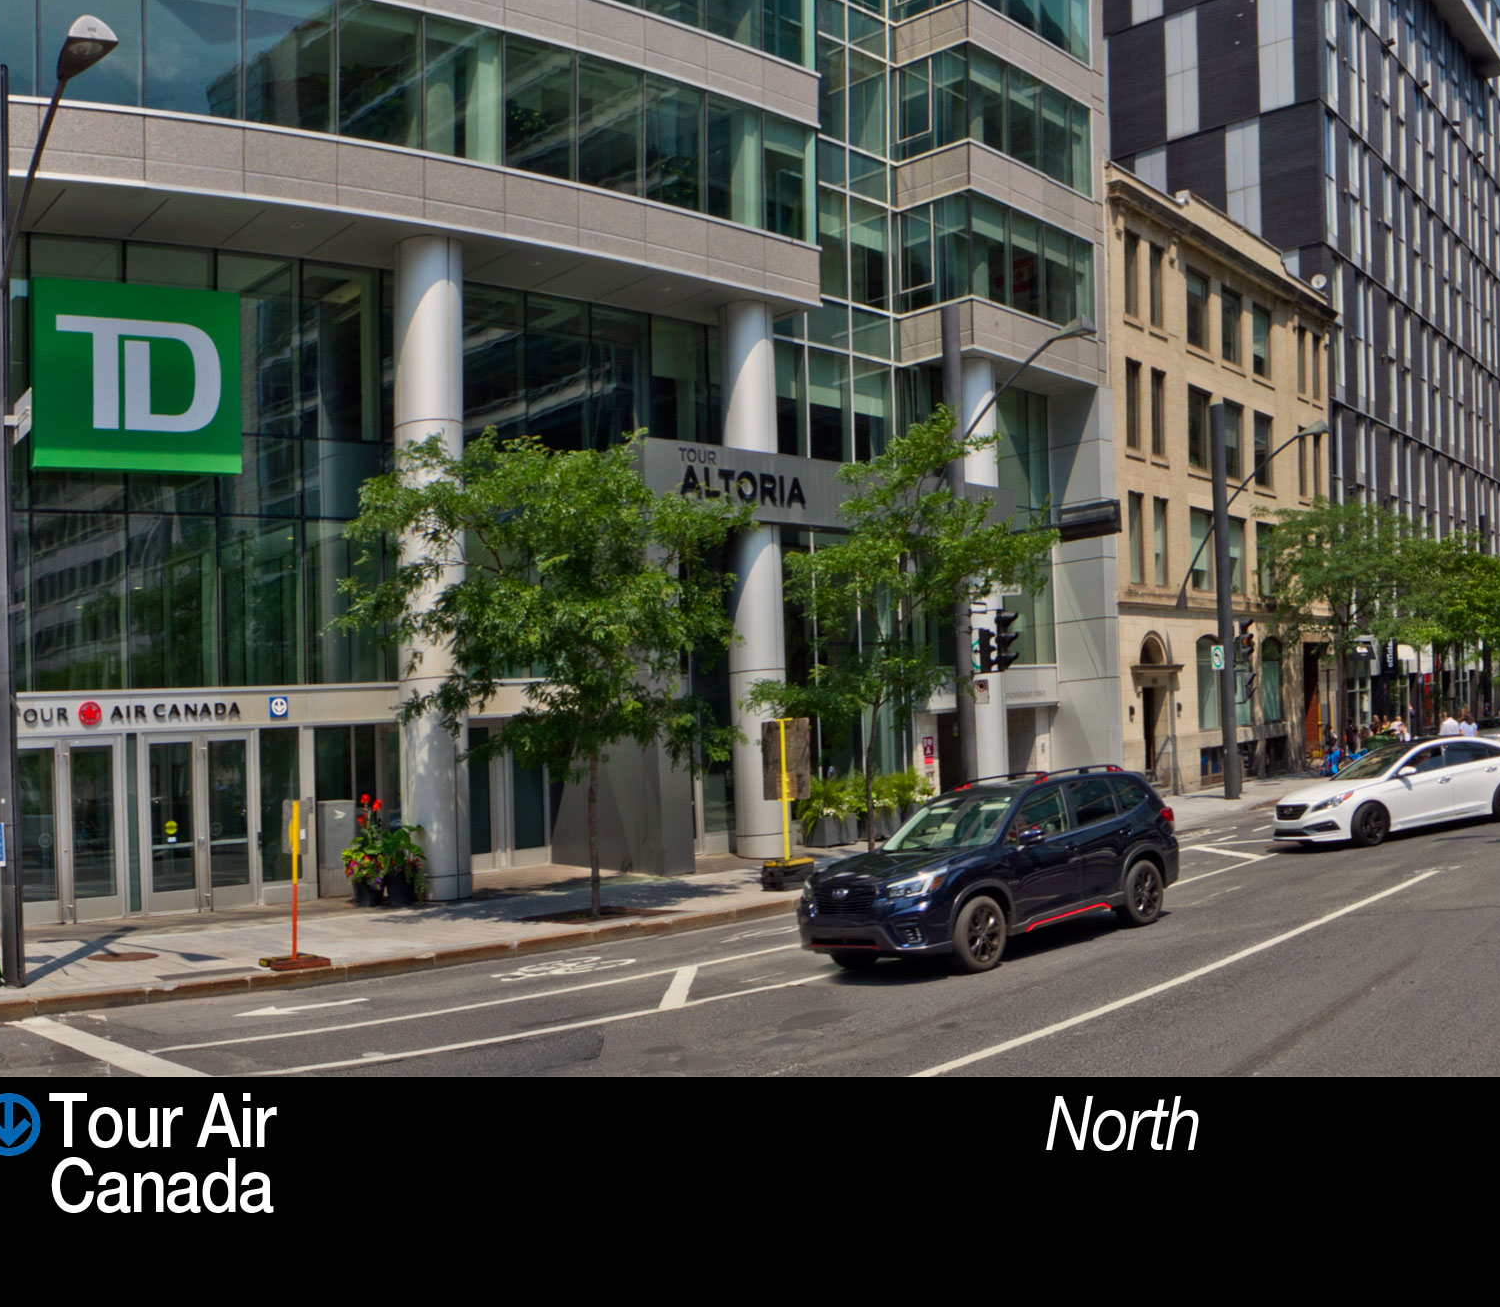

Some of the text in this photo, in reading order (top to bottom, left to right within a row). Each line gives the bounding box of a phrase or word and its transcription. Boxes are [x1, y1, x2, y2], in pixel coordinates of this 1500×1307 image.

[55, 314, 222, 433] TD
[679, 447, 716, 464] TOUR
[680, 465, 806, 509] ALTORIA
[23, 707, 69, 723] OUR
[110, 705, 147, 719] AIR
[152, 702, 241, 718] CANADA
